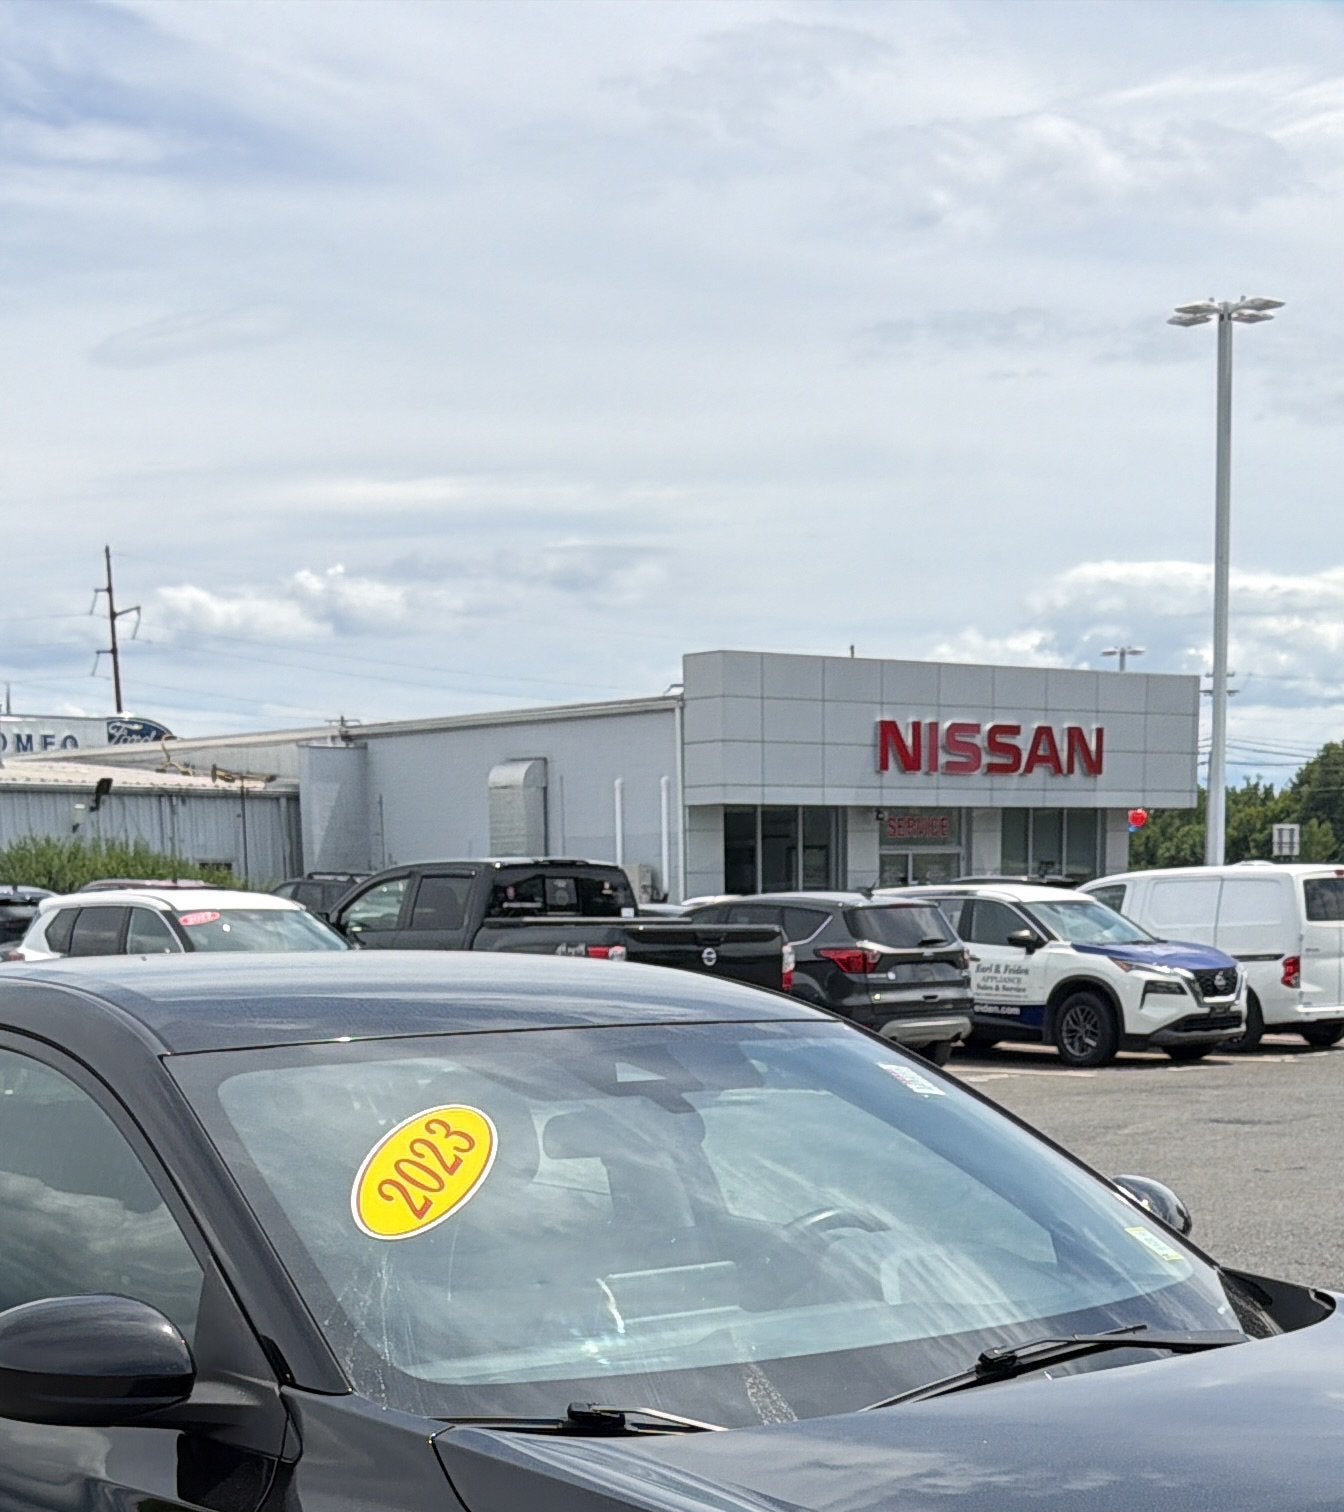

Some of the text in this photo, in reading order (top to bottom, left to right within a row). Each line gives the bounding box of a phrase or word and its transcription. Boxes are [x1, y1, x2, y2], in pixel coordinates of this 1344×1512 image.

[878, 719, 1104, 775] NISSAN
[887, 815, 950, 838] SERVICE
[377, 1118, 476, 1220] 2023
